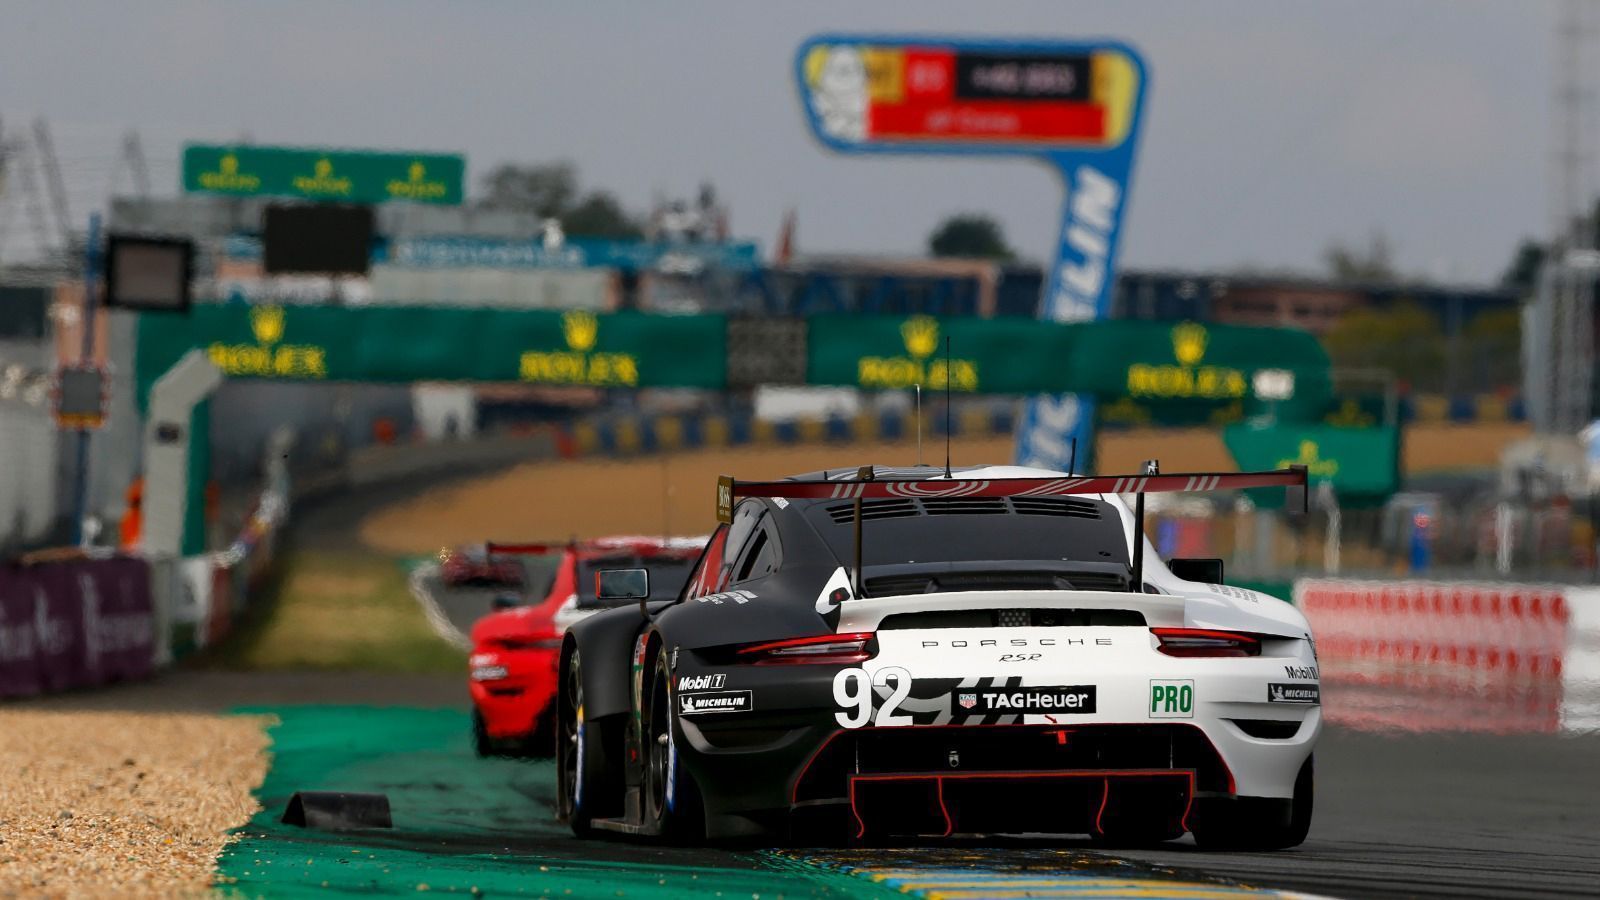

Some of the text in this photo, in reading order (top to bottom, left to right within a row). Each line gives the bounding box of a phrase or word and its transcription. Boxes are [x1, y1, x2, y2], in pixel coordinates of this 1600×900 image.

[519, 351, 639, 386] ROLEX
[857, 355, 980, 392] ROLEX
[1126, 363, 1247, 398] ROLEX
[921, 638, 1113, 649] PORSCHE
[998, 653, 1043, 663] RSR
[678, 674, 712, 691] Mobil
[1285, 689, 1318, 699] MICHELIN
[695, 696, 746, 708] MICHELIN
[832, 666, 914, 730] 92
[1151, 684, 1193, 713] PRO
